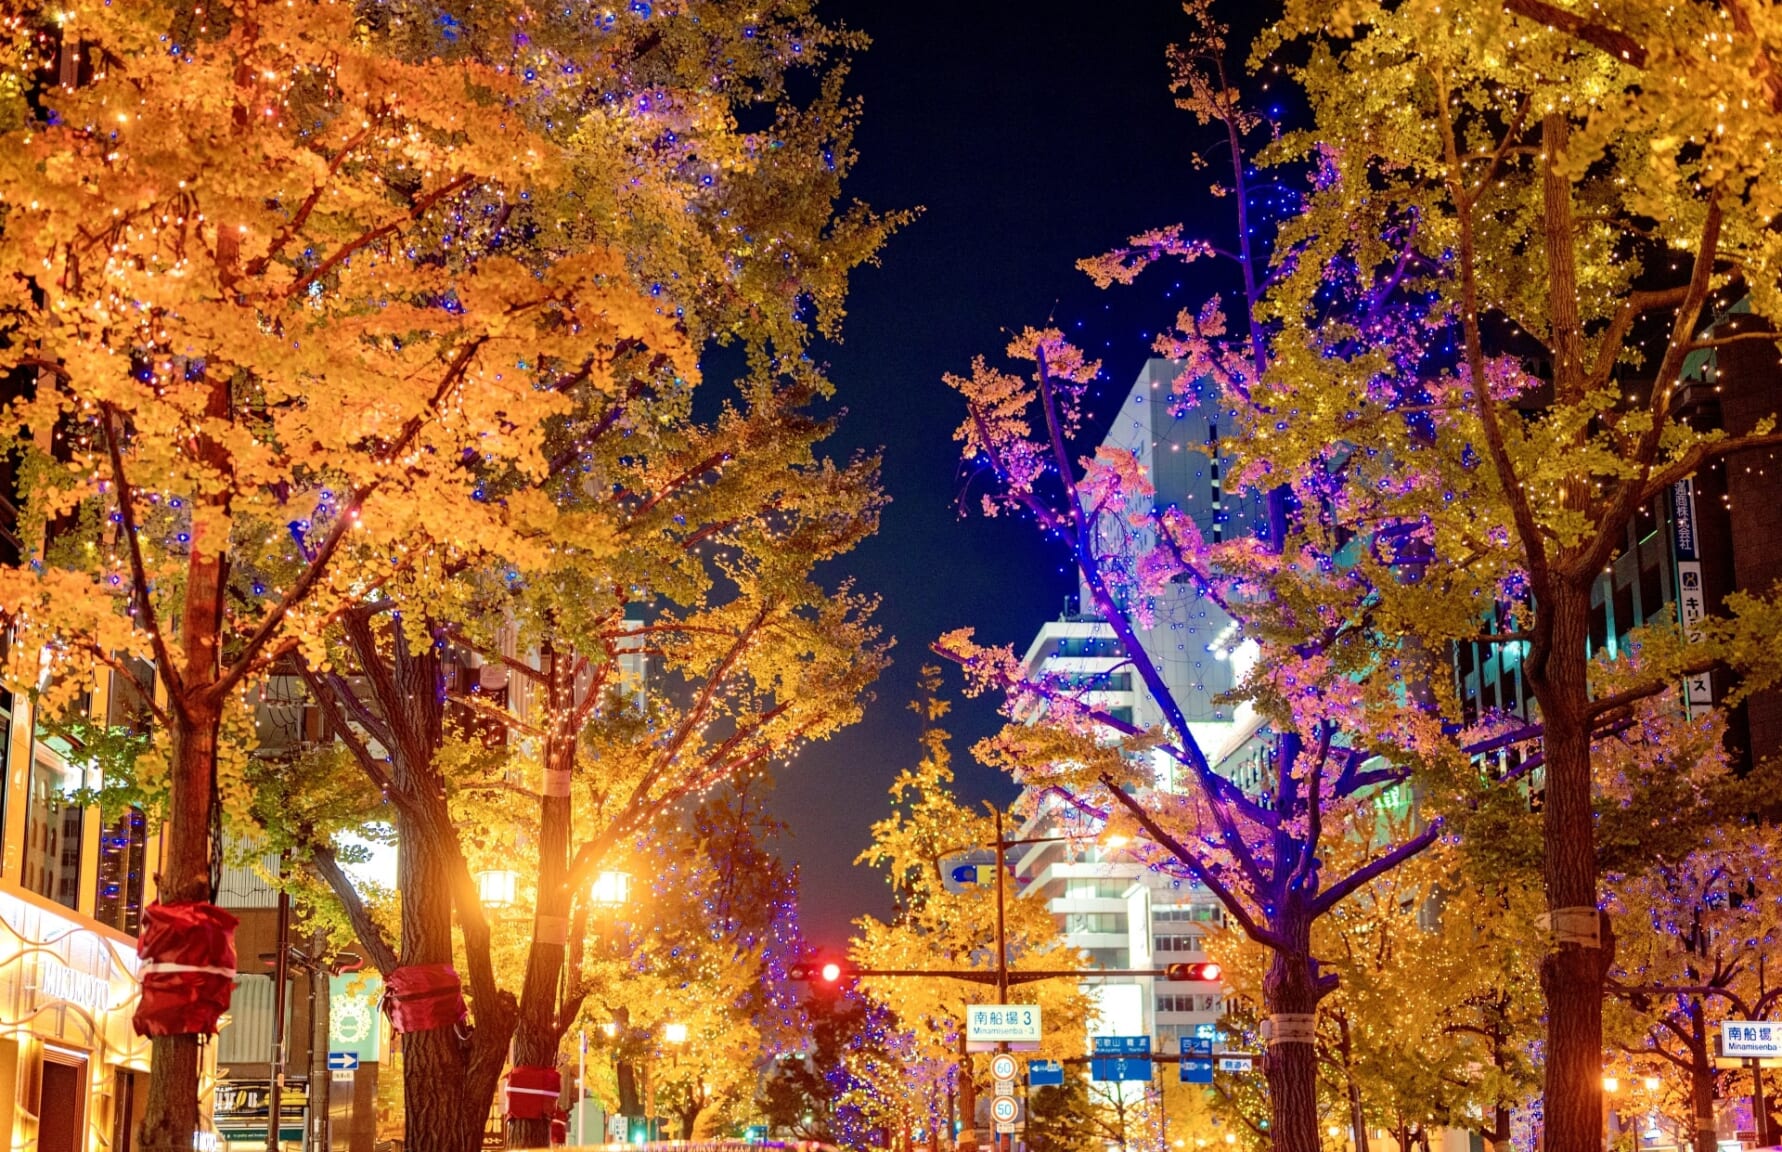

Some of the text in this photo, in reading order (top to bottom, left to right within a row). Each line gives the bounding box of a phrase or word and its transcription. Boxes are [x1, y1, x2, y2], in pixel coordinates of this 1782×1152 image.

[974, 1011, 1032, 1025] 南船場 3
[1728, 1027, 1771, 1041] 南船場
[1728, 1042, 1777, 1051] Minamisenba
[997, 1062, 1011, 1073] 60
[997, 1103, 1012, 1115] 50
